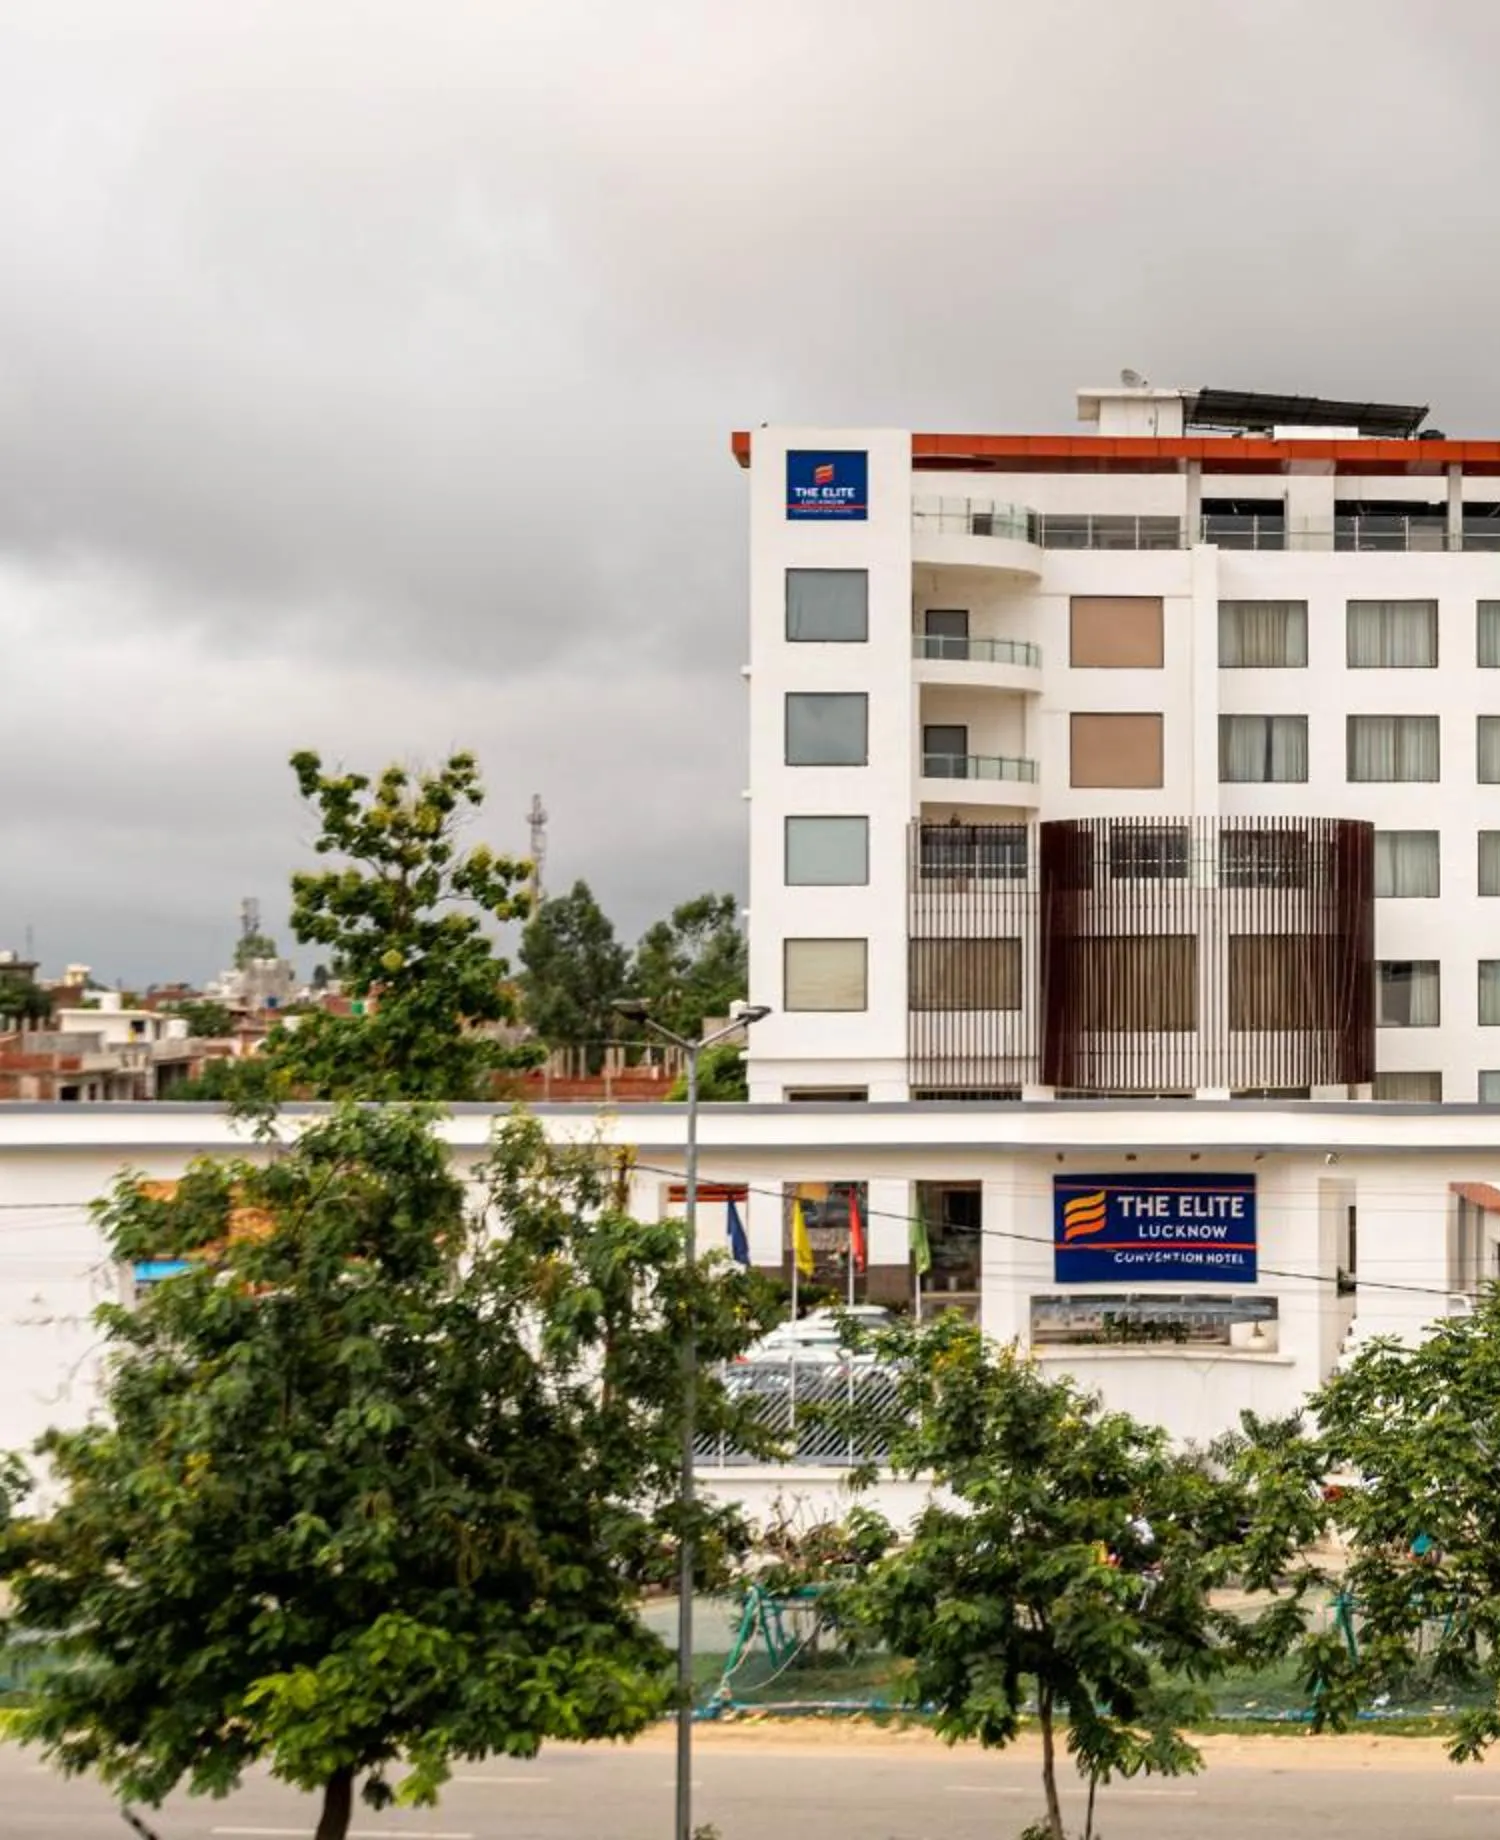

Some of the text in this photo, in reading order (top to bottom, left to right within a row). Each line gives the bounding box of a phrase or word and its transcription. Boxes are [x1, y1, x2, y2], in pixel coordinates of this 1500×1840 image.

[1117, 1195, 1245, 1218] THE ELITE
[1138, 1224, 1228, 1239] LUCKNOW
[1113, 1252, 1245, 1265] CONVENTION HOTEL
